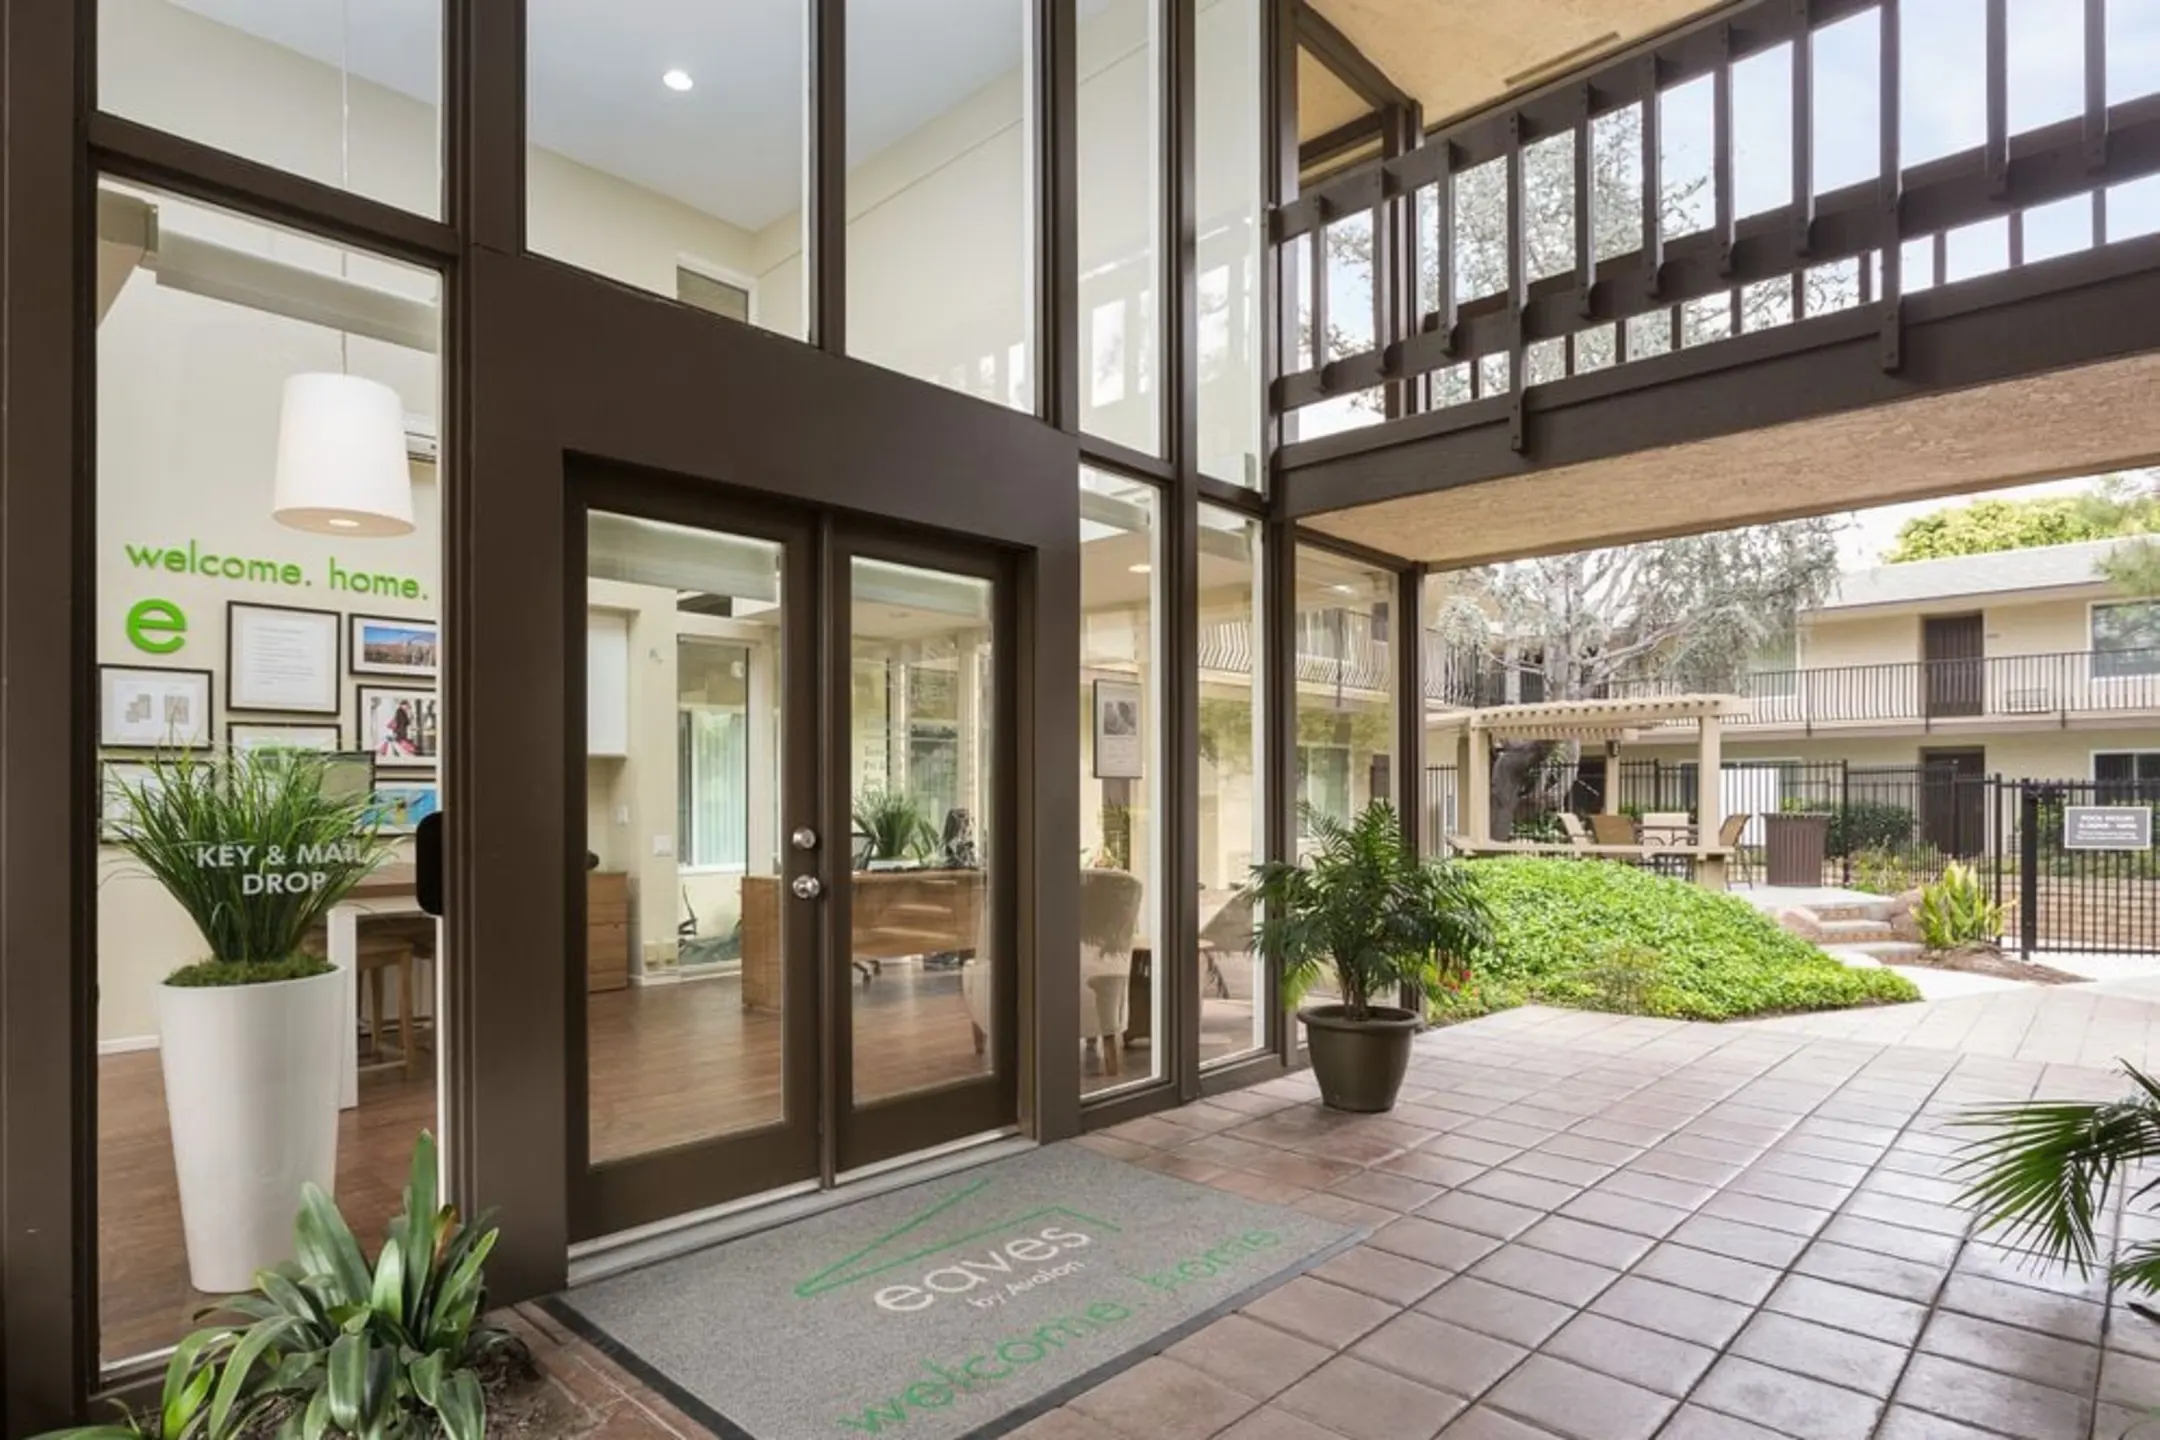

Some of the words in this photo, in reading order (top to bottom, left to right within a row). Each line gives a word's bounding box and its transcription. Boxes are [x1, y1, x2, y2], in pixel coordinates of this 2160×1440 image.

[124, 540, 312, 587] welcome.
[328, 556, 429, 601] home.
[125, 598, 188, 655] e
[196, 845, 256, 868] KEY
[265, 844, 287, 866] &
[242, 871, 328, 895] DROP
[874, 1227, 1092, 1311] eaves
